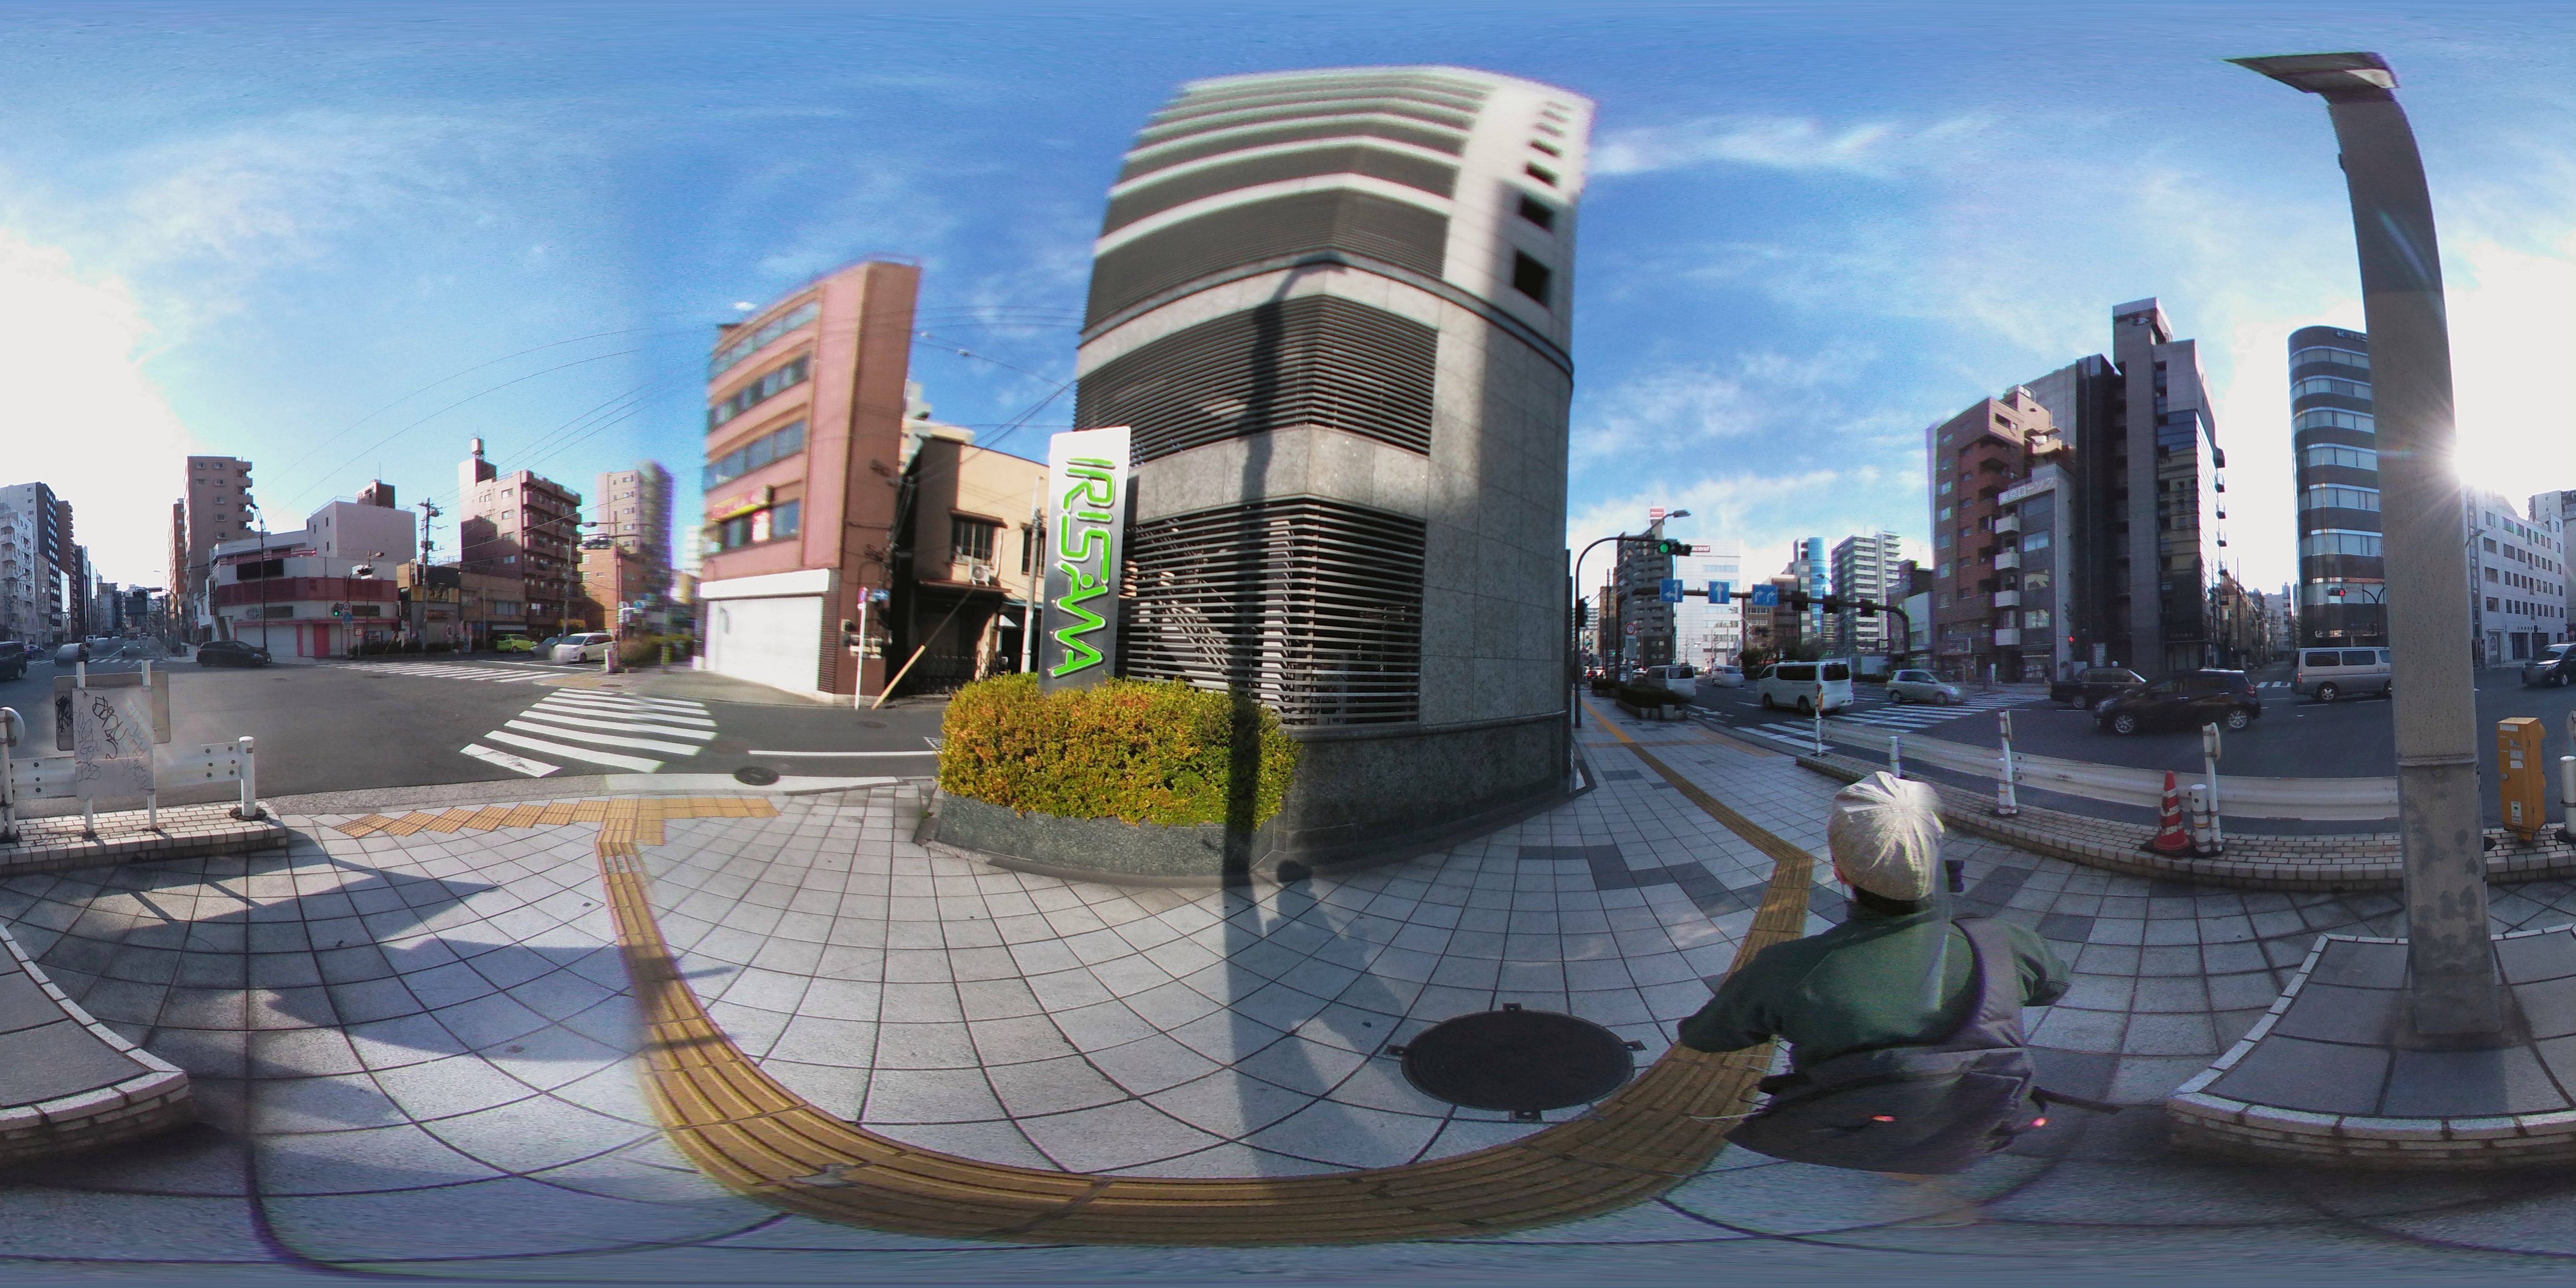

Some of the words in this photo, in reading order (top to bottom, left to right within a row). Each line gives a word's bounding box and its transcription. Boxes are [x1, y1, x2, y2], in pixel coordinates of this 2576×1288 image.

[2001, 477, 2054, 502] 東京ローソク
[1052, 457, 1116, 679] IRISAWA
